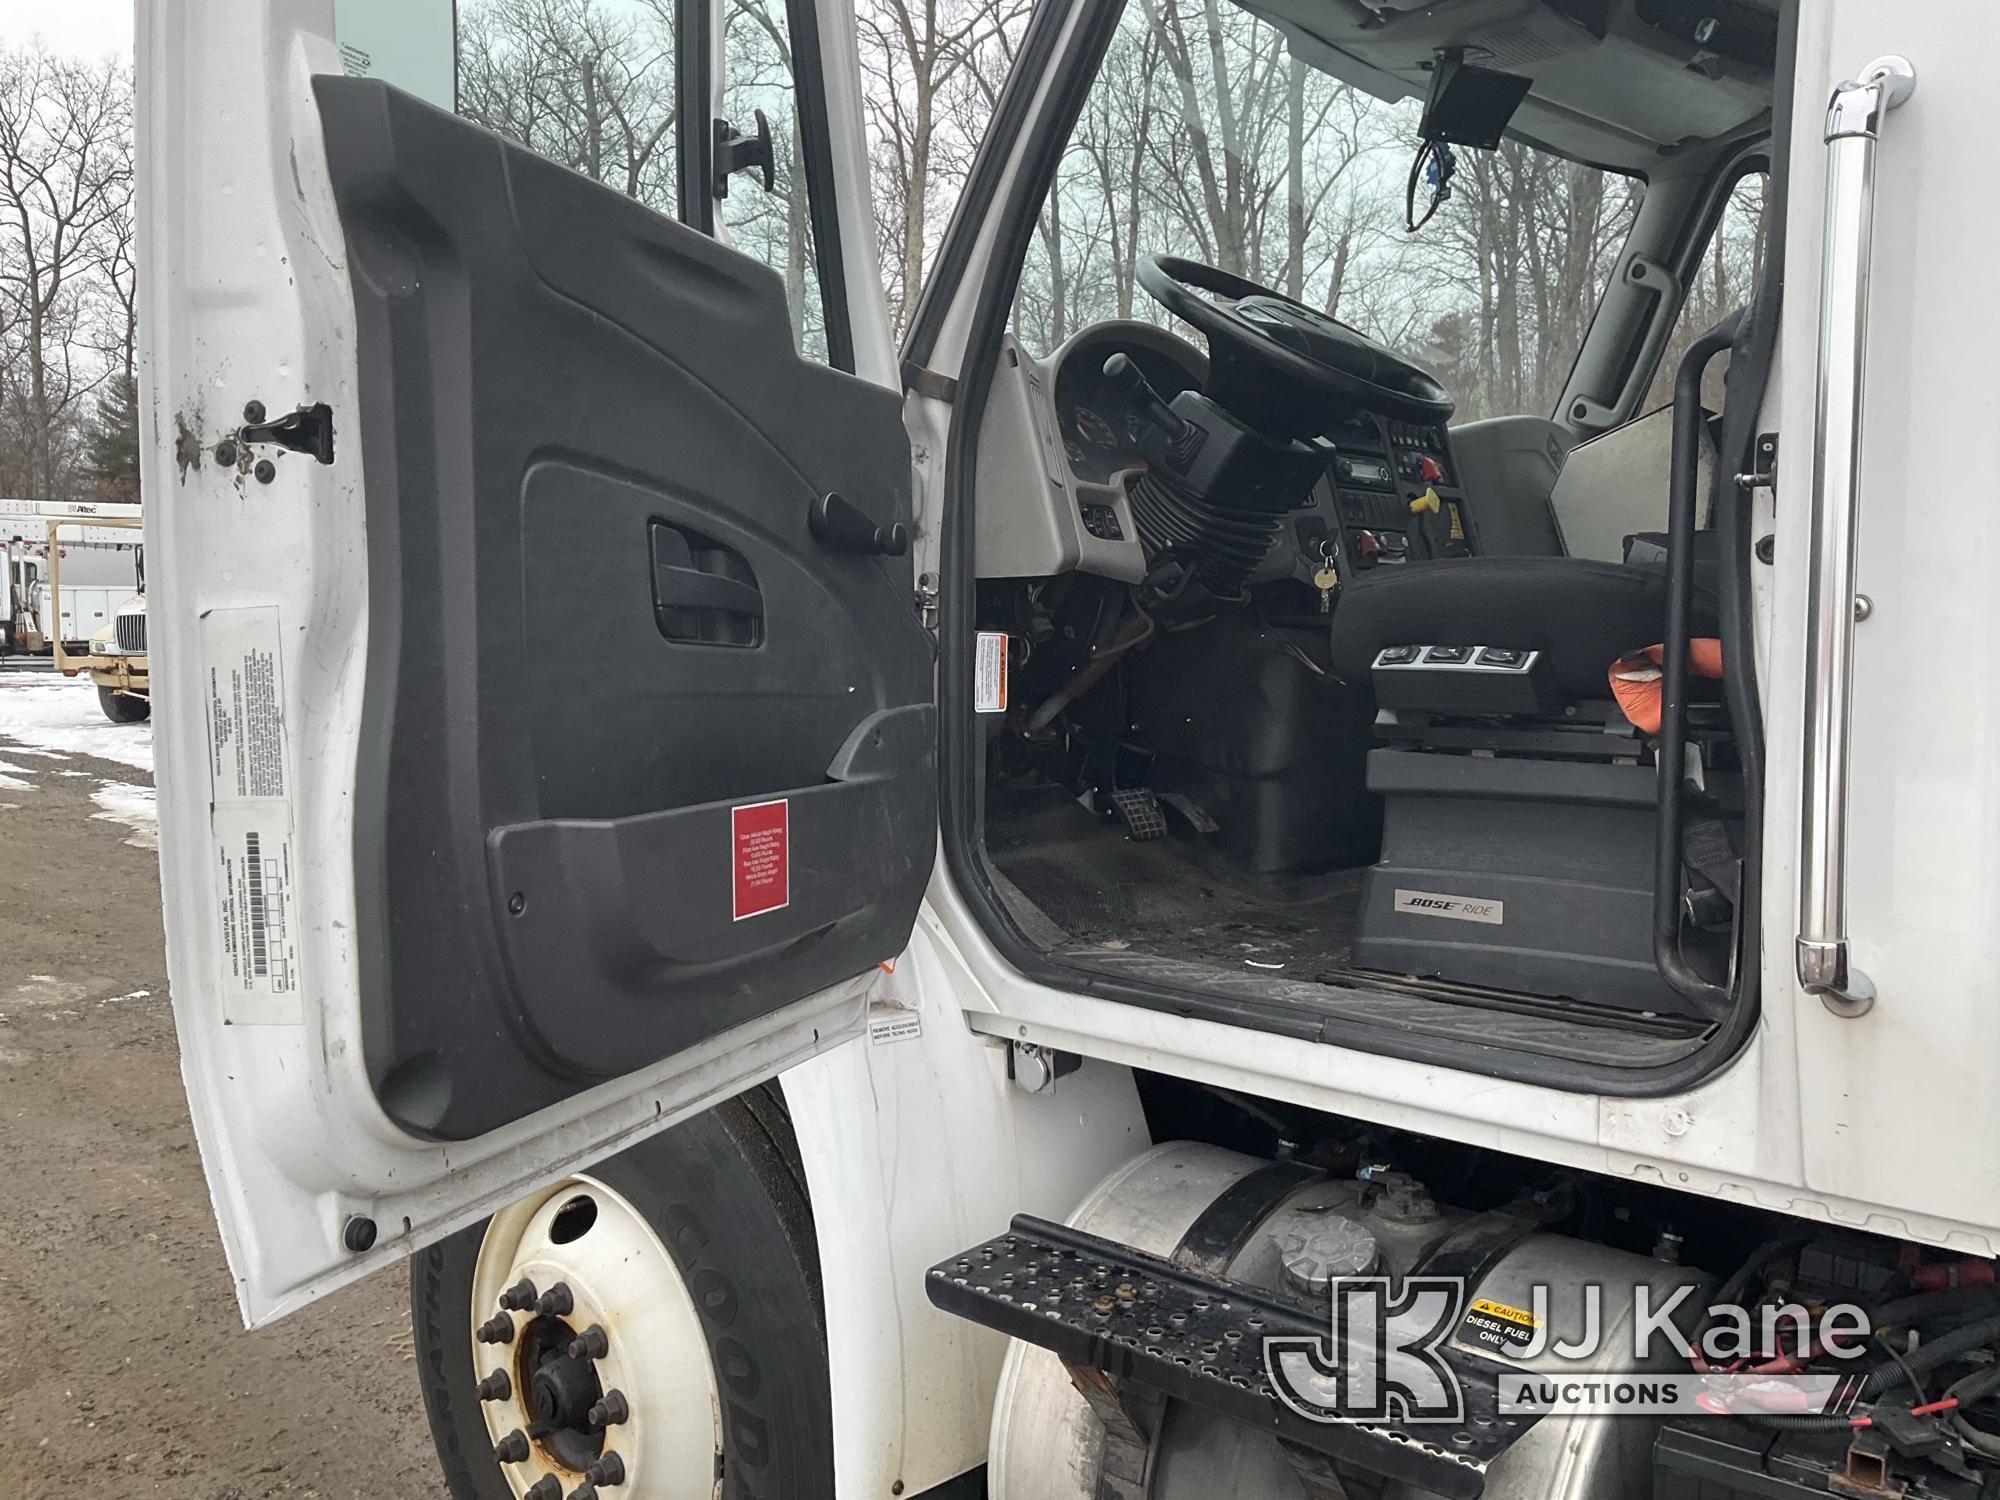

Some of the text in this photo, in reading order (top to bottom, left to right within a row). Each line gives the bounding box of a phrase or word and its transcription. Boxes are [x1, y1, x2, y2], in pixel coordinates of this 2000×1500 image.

[77, 505, 96, 514] Altec
[1402, 898, 1493, 916] BOSE RIDE
[1494, 1306, 1536, 1323] CAUTION
[1466, 1315, 1531, 1341] DIESEL FUEL
[1480, 1332, 1507, 1345] ONLY
